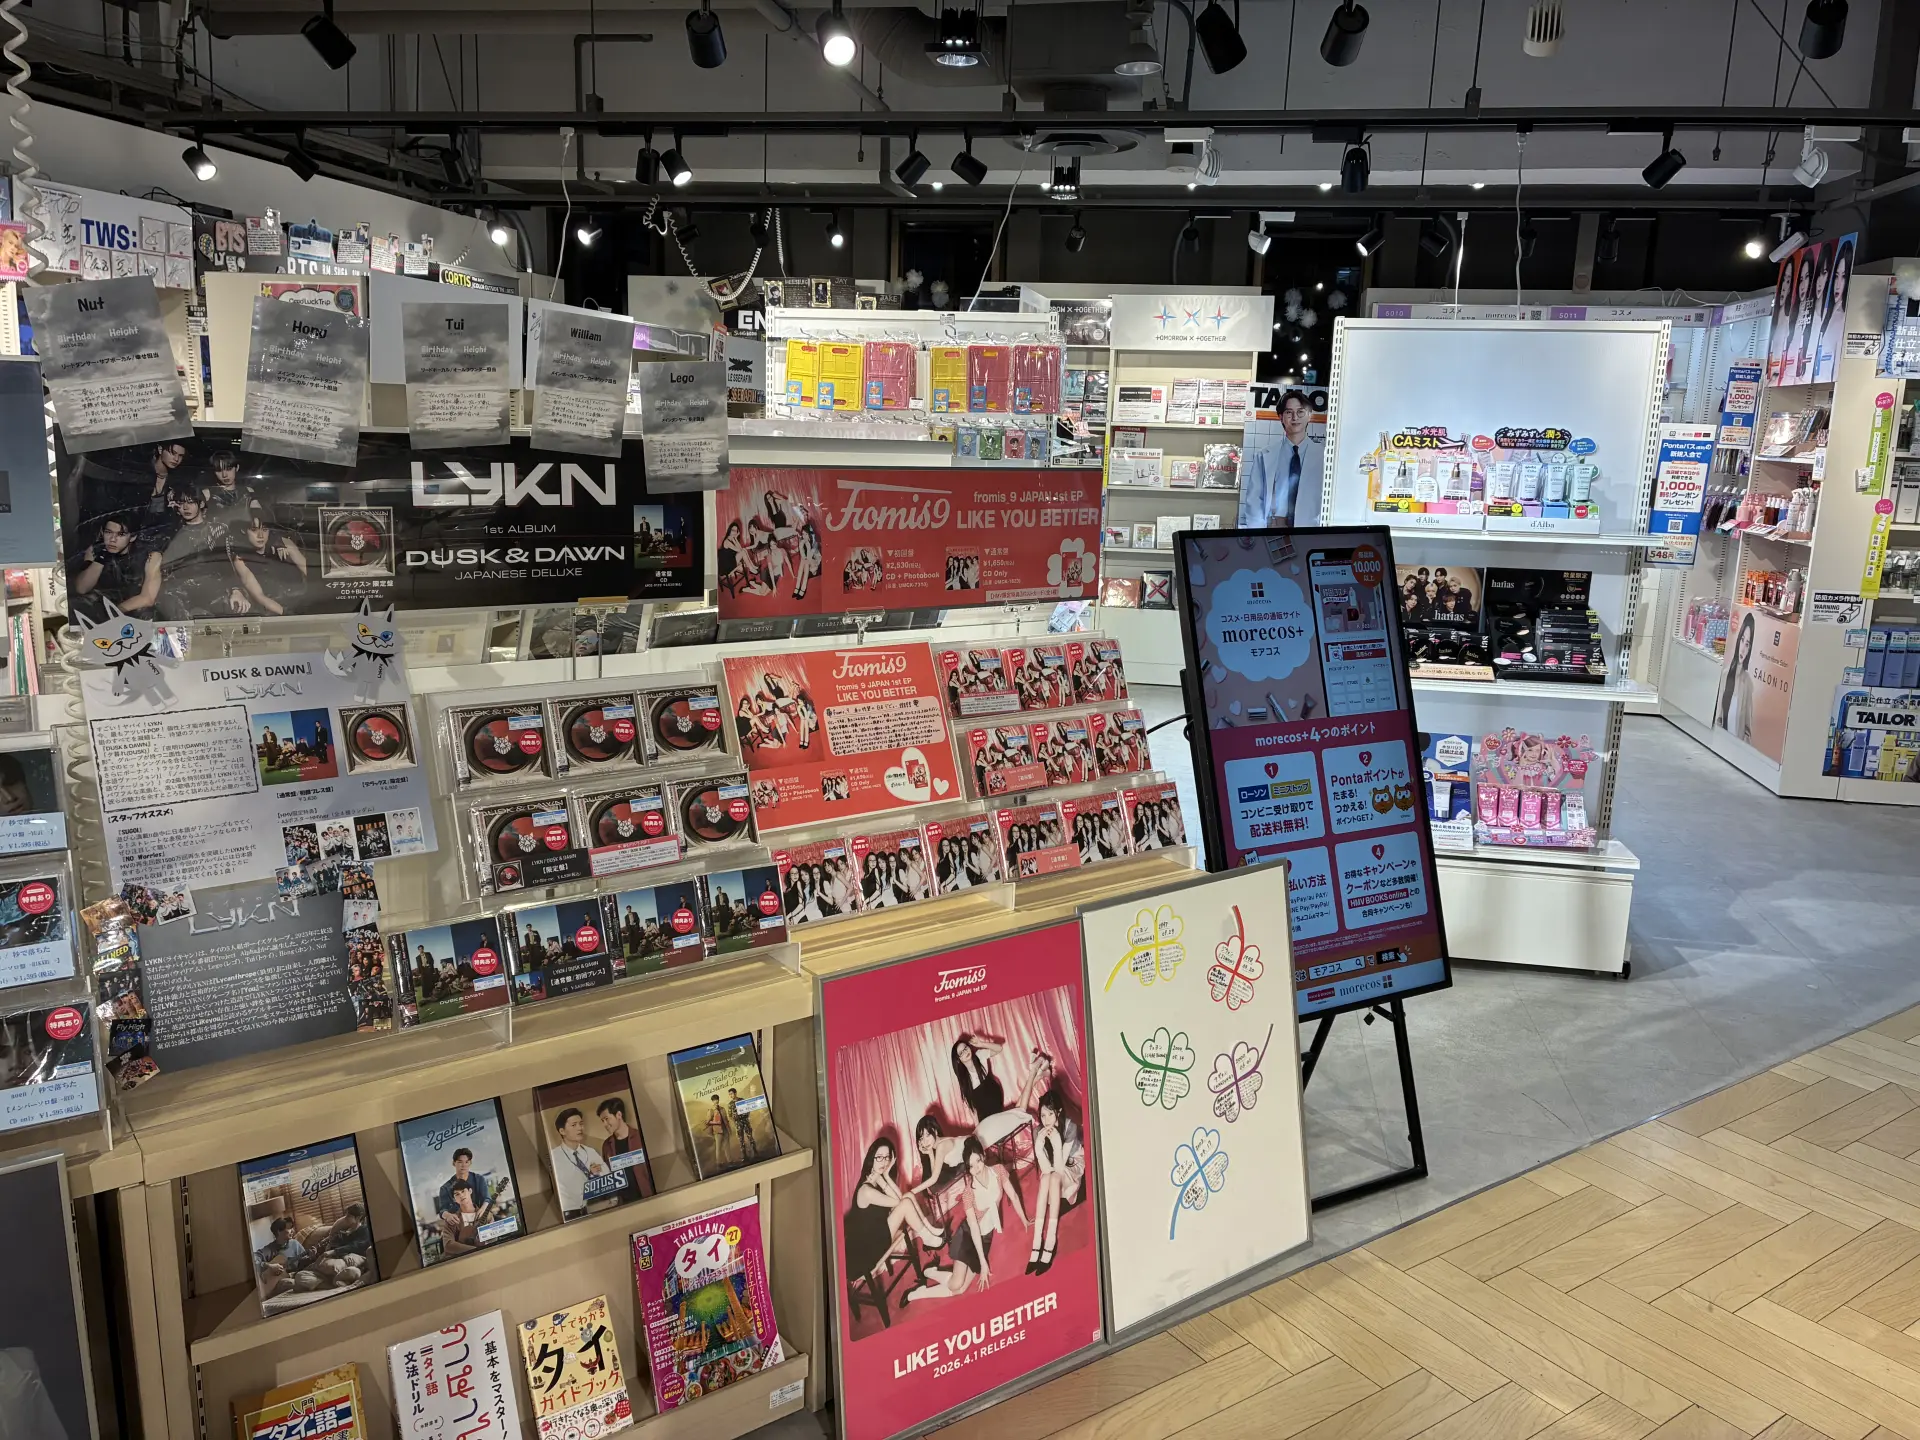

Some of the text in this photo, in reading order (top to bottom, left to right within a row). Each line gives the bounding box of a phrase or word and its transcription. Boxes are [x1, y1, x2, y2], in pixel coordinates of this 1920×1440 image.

[216, 221, 245, 254] BTS
[444, 269, 472, 288] CORTIS
[78, 297, 105, 313] Nut
[445, 318, 465, 330] Tui
[57, 326, 139, 343] Birthday Height
[570, 328, 602, 342] William
[269, 345, 304, 358] Birthday
[316, 353, 342, 364] Height
[421, 345, 487, 354] Birthday Height
[670, 373, 694, 384] Lego
[1394, 435, 1440, 448] CAミスト
[1507, 428, 1561, 439] みずみずしく潤う
[409, 461, 616, 507] LYKN
[1660, 481, 1702, 491] 1,000円
[1020, 490, 1051, 503] JAPAN
[1054, 490, 1068, 502] 1st
[1070, 489, 1084, 502] EP
[957, 507, 1099, 529] LIKE YOU BETTER
[1530, 520, 1555, 528] d'Alba
[483, 524, 556, 534] 1st ALBUM
[406, 544, 625, 568] DUSK & DAWN
[1650, 550, 1674, 559] 548円
[454, 567, 583, 580] JAPANESE DELUXE
[994, 569, 1008, 578] Only
[1353, 560, 1381, 573] 10,000
[903, 572, 940, 580] Photobook
[1491, 579, 1515, 589] harias
[1220, 611, 1301, 623] コスメ・日用品の通販サイト
[1434, 610, 1464, 621] harias
[1222, 626, 1305, 644] morecos+
[1250, 647, 1281, 657] モアコス
[251, 666, 262, 677] &
[867, 679, 890, 688] JAPAN
[891, 678, 901, 686] 1st
[903, 677, 912, 685] EP
[1753, 667, 1789, 693] SALON 10
[837, 686, 918, 703] LIKE YOU BETTER
[1856, 711, 1915, 727] TAILOR
[1362, 753, 1369, 763] 2
[1331, 768, 1405, 787] Pontaポイントが
[1240, 783, 1309, 800] ローソン ミニストップ
[1333, 789, 1358, 801] たまる!
[1241, 801, 1314, 820] コンビニ受け取りで
[1334, 801, 1367, 813] つかえる!
[1250, 817, 1309, 838] 配送料無料!
[1375, 846, 1382, 857] 4
[1344, 859, 1417, 880] お得なキャンペーンや
[22, 892, 51, 904] 特典あり
[1350, 888, 1420, 908] HMV BOOKS online との
[12, 944, 50, 957] 秒で落ちた
[1314, 963, 1342, 976] モアコス
[956, 988, 972, 998] JAPAN
[1340, 979, 1381, 997] morecos
[48, 1019, 80, 1030] 特典あり
[693, 1074, 748, 1099] Thousand Stars
[711, 1072, 728, 1085] Tale
[38, 1081, 77, 1096] 秒で落ちた
[426, 1116, 478, 1150] 2gether
[301, 1163, 359, 1201] 2gether
[584, 1174, 614, 1194] SOTUS
[673, 1223, 726, 1248] THAILAND
[637, 1237, 651, 1268] るるぶ
[682, 1238, 721, 1272] タイ
[528, 1309, 605, 1343] イラストでわかる
[893, 1292, 1058, 1378] LIKE YOU BETTER
[531, 1324, 607, 1394] タイ
[933, 1329, 1026, 1378] 2026.4.1 RELEASE
[403, 1350, 425, 1416] 文法ドリル
[423, 1357, 438, 1396] タイ語
[540, 1370, 620, 1413] ガイドブック
[287, 1397, 315, 1418] 入門
[263, 1404, 338, 1440] タイ語
